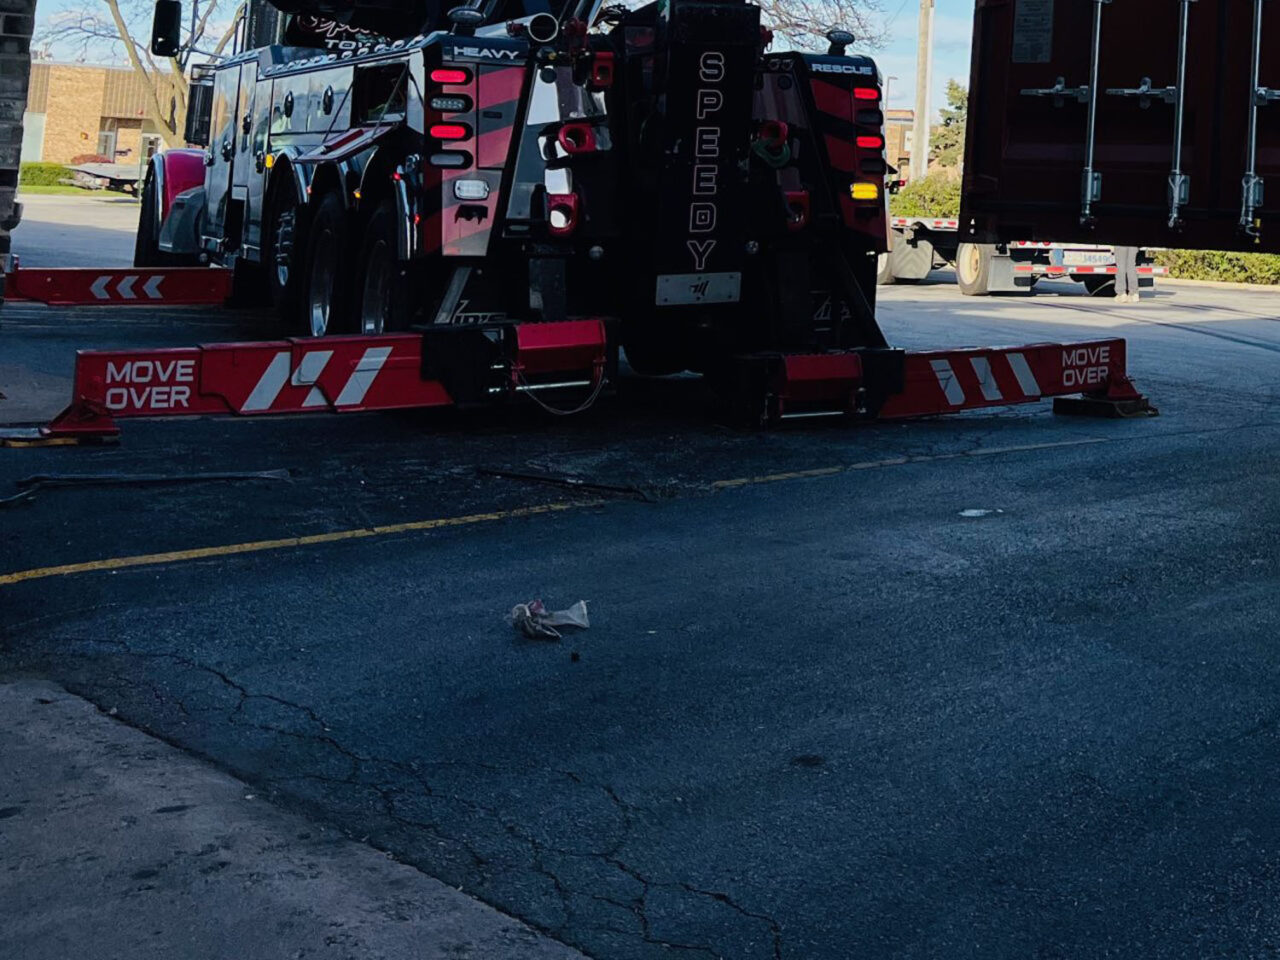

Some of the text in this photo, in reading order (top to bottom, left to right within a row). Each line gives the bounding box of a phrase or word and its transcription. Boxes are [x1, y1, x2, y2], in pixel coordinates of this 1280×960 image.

[453, 45, 520, 60] HEAVY
[811, 63, 873, 76] RESCUE
[686, 51, 726, 271] SPEEDY
[1062, 346, 1110, 367] MOVE
[105, 359, 195, 384] MOVE
[1063, 365, 1109, 387] OVER
[105, 385, 191, 410] OVER
